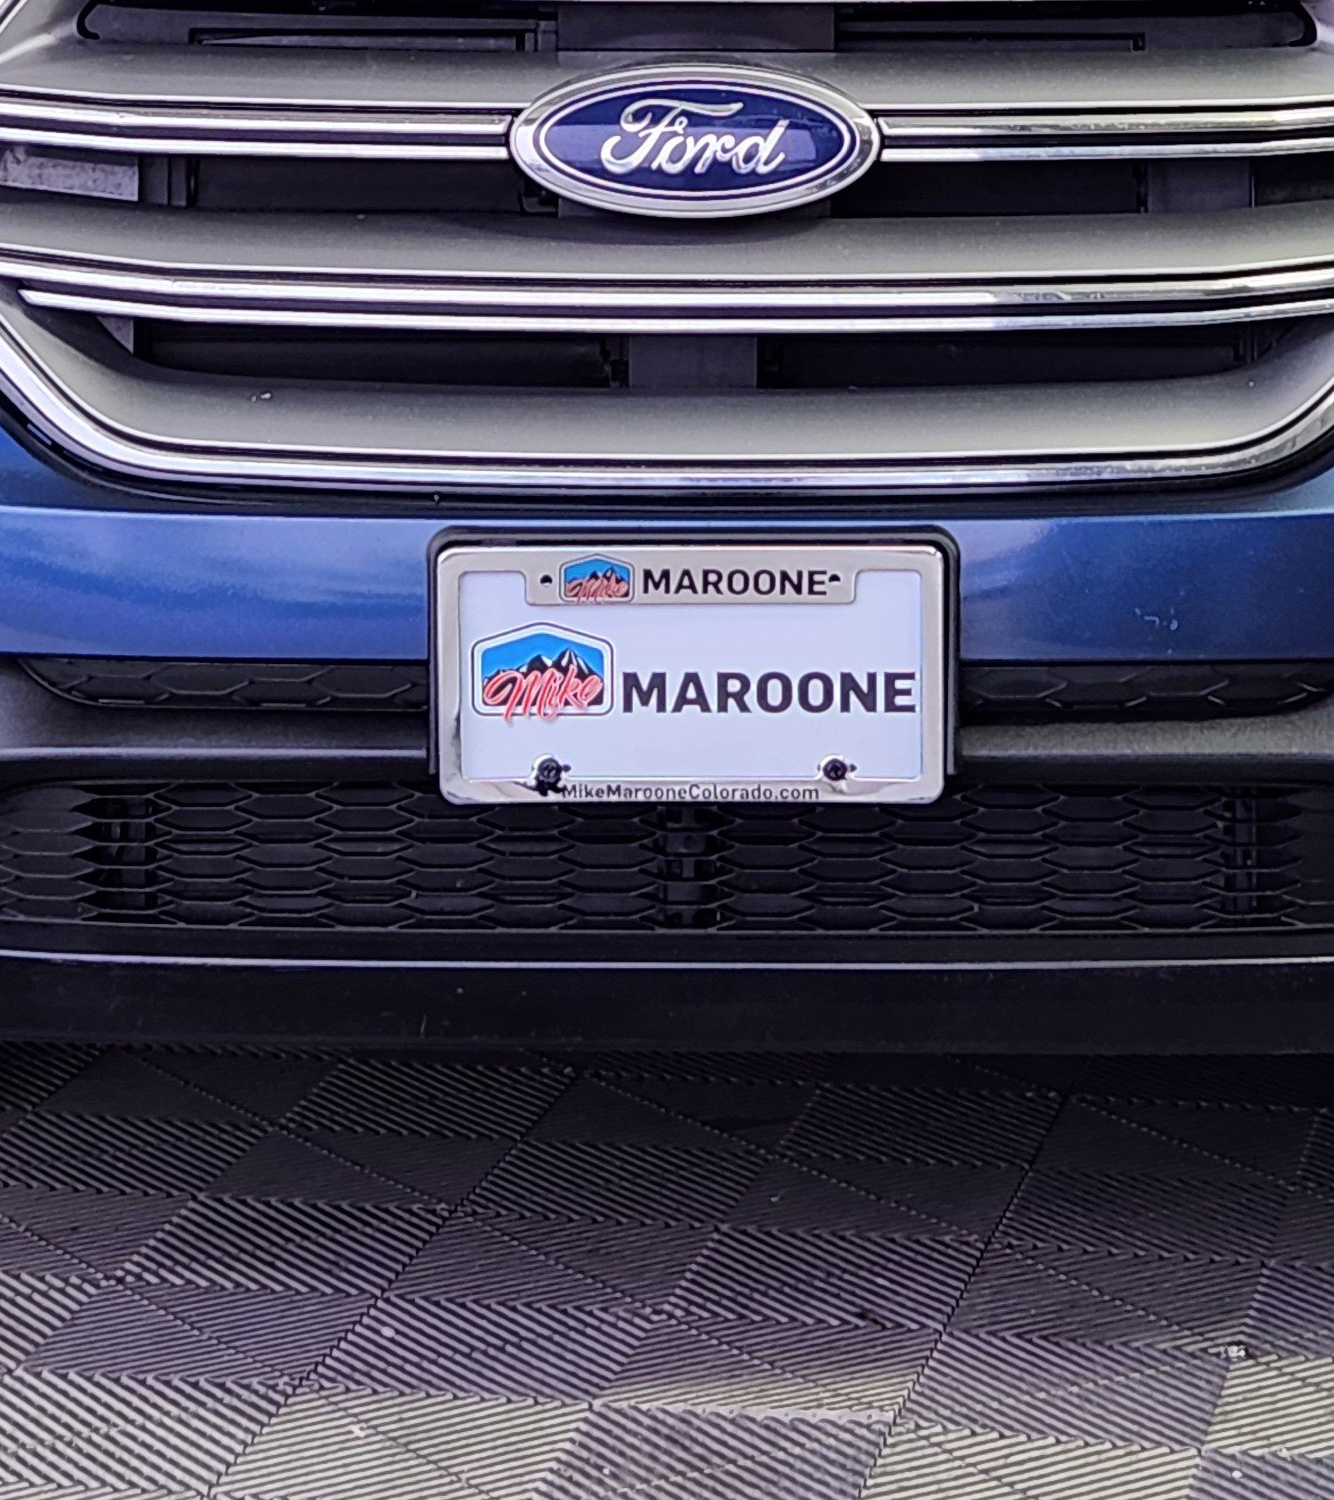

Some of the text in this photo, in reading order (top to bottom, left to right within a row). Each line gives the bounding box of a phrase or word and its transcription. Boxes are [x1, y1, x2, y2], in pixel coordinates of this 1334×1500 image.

[600, 98, 789, 175] Ford
[643, 568, 827, 596] MAROONE
[483, 664, 916, 723] Mike MAROONE
[562, 783, 820, 799] MikeMarooneColorado.com
